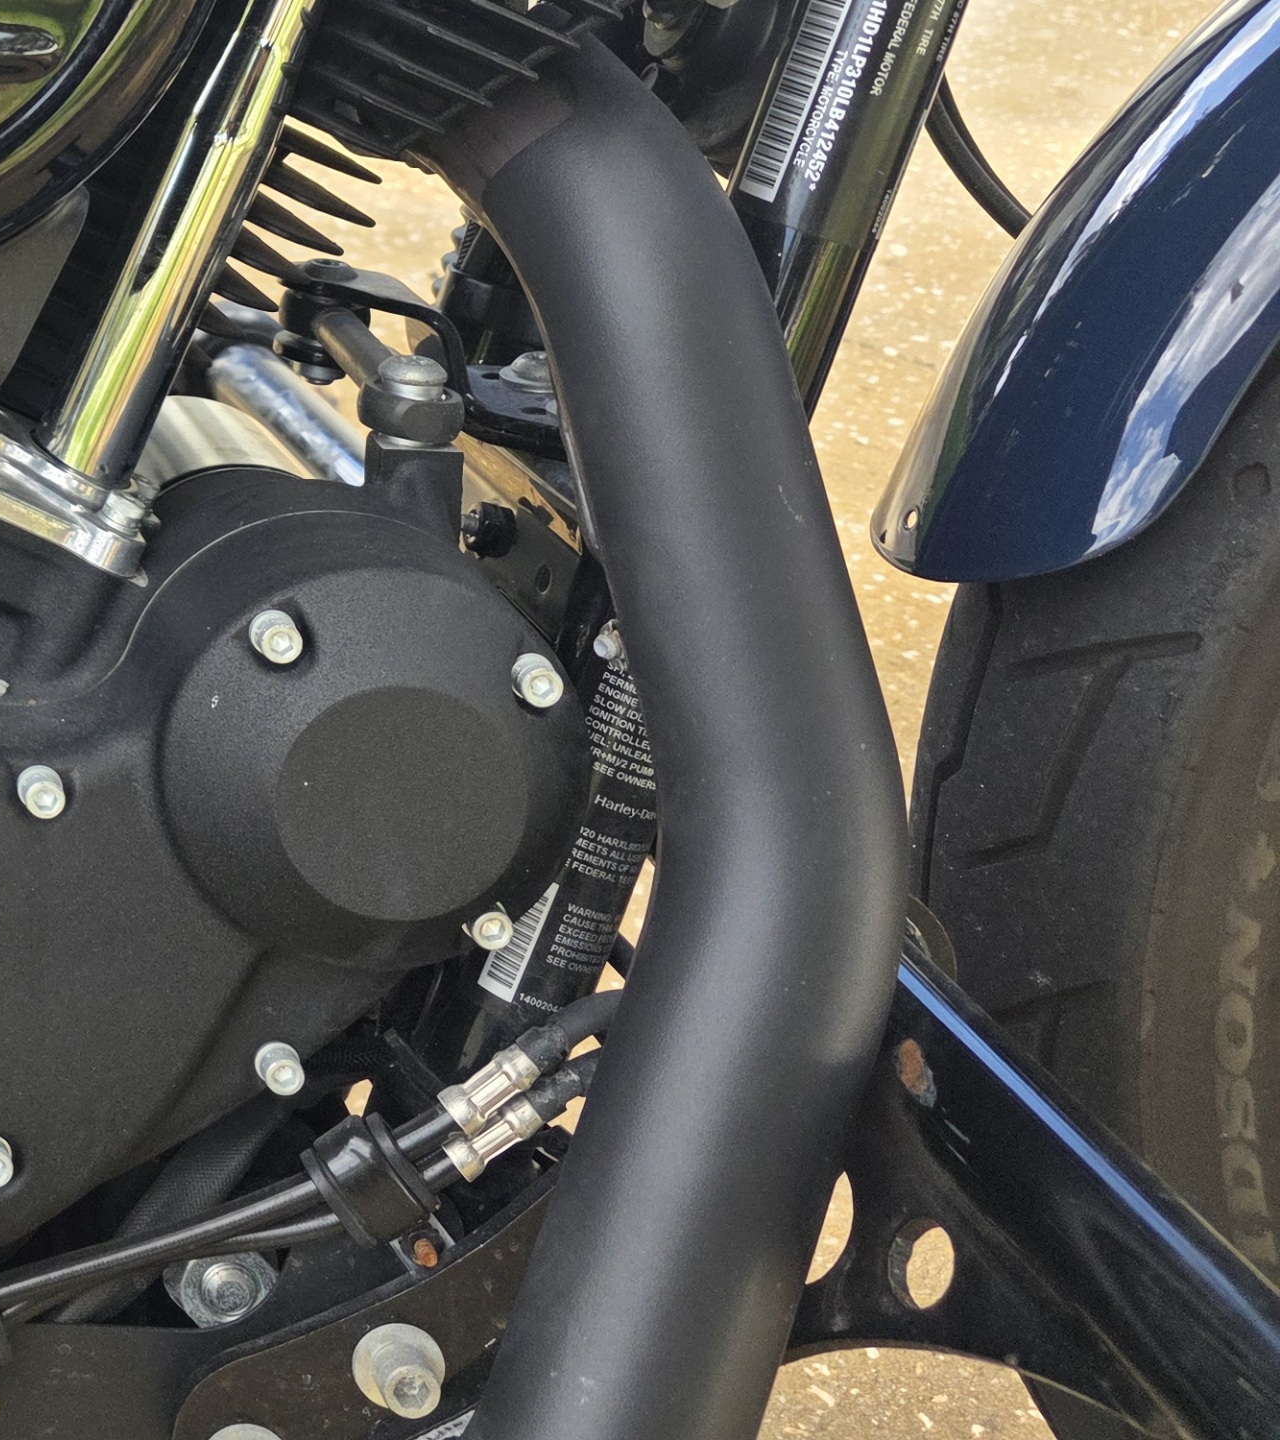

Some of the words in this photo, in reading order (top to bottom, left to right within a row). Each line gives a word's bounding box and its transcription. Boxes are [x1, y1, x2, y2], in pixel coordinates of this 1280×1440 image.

[914, 27, 934, 56] TIRE
[824, 47, 849, 85] TYPE:
[868, 50, 896, 97] MOTOR
[791, 84, 834, 167] MOTORCYCLE
[597, 682, 640, 708] ENGINE
[588, 704, 636, 733] IGNITION
[593, 693, 627, 715] SLOW
[626, 709, 644, 724] IDL
[592, 761, 616, 777] SEE
[609, 850, 627, 861] ALL
[571, 860, 616, 883] FEDERAL
[558, 923, 598, 943] EXCEED
[562, 913, 597, 931] CAUSE
[545, 954, 567, 969] SEE
